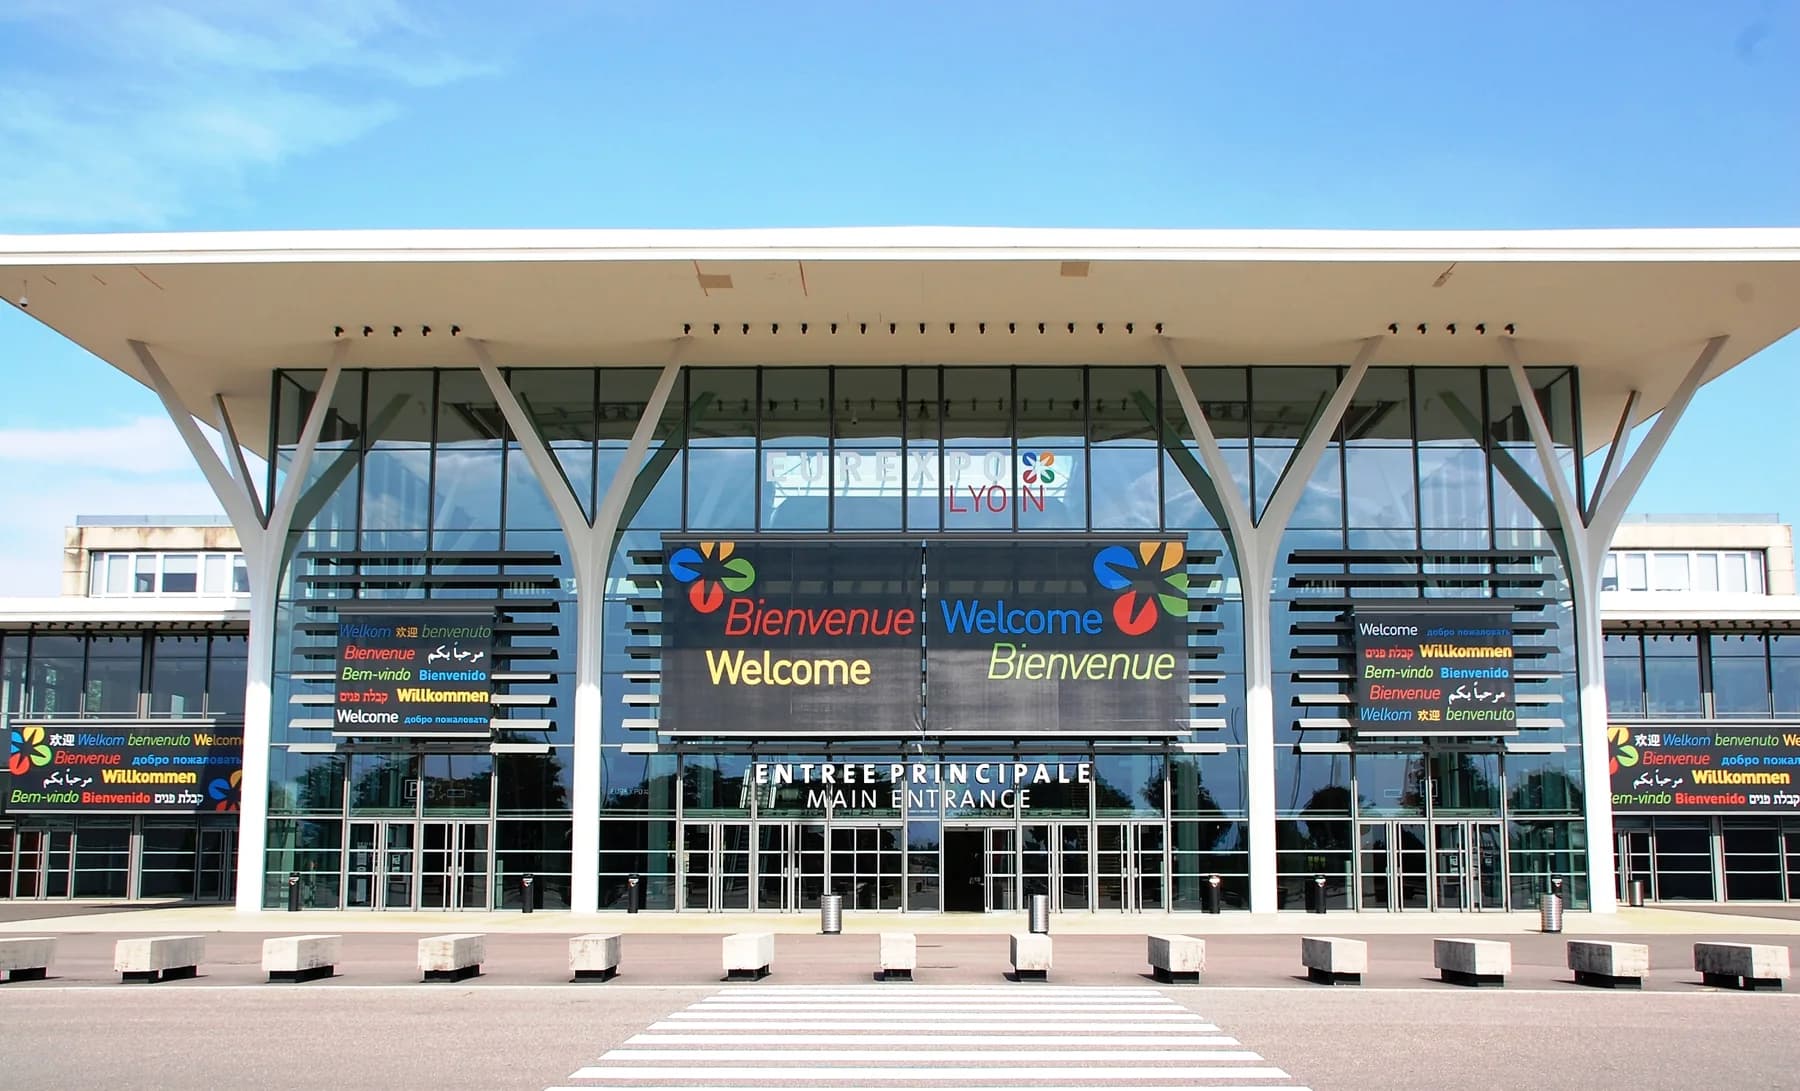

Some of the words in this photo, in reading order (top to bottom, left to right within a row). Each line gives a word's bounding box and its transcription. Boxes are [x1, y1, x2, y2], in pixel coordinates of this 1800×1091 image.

[766, 451, 1006, 482] EUREXPO
[949, 485, 1045, 513] LYON
[725, 599, 915, 636] Bienvenue
[940, 599, 1103, 635] Welcome
[340, 624, 391, 638] Welkom
[395, 626, 418, 638] 欢迎
[422, 624, 491, 638] benvenuto
[1359, 623, 1418, 636] Welcome
[1427, 626, 1455, 637] добро
[344, 645, 416, 660] Bienvenue
[427, 645, 450, 664] بكم
[1365, 648, 1386, 658] פנים
[1388, 645, 1414, 660] קבלת
[1419, 644, 1513, 658] Willkommen
[705, 649, 871, 686] Welcome
[988, 642, 1176, 680] Bienvenue
[342, 666, 411, 681] Bem-vindo
[419, 669, 486, 681] Bienvenido
[1365, 665, 1434, 679] Bem-vindo
[1440, 667, 1509, 679] Bienvenido
[339, 692, 361, 702] פנים
[363, 688, 389, 704] קבלת
[396, 688, 489, 703] Willkommen
[1369, 684, 1441, 700] Bienvenue
[1448, 685, 1471, 704] بكم
[337, 709, 399, 723] Welcome
[404, 714, 433, 725] добро
[1360, 708, 1412, 721] Welkom
[1417, 709, 1441, 721] 欢迎
[1446, 707, 1515, 721] benvenuto
[49, 734, 75, 747] 欢迎
[78, 734, 125, 746] Welkom
[128, 733, 191, 746] benvenuto
[193, 733, 243, 746] Welcom
[1634, 734, 1661, 747] 欢迎
[1663, 734, 1711, 746] Welkom
[1715, 733, 1779, 746] benvenuto
[54, 750, 121, 765] Bienvenue
[132, 755, 169, 767] добро
[1643, 751, 1711, 765] Bienvenue
[1721, 755, 1759, 767] добро
[1763, 757, 1800, 765] пожал
[43, 771, 64, 788] بكم
[102, 769, 197, 784] Willkommen
[755, 763, 876, 784] ENTREE
[891, 763, 1091, 784] PRINCIPALE
[1633, 772, 1653, 789] بكم
[1692, 770, 1790, 784] Willkommen
[11, 789, 79, 803] Bem-vindo
[82, 792, 150, 804] Bienvenido
[154, 793, 175, 803] פנים
[177, 789, 204, 807] קבלת
[806, 789, 877, 809] MAIN
[892, 789, 1030, 809] ENTRANCE
[1612, 791, 1672, 805] em-vindo
[1675, 793, 1745, 805] Bienvenido
[1749, 794, 1771, 805] פנים
[1773, 790, 1800, 807] קבלת
